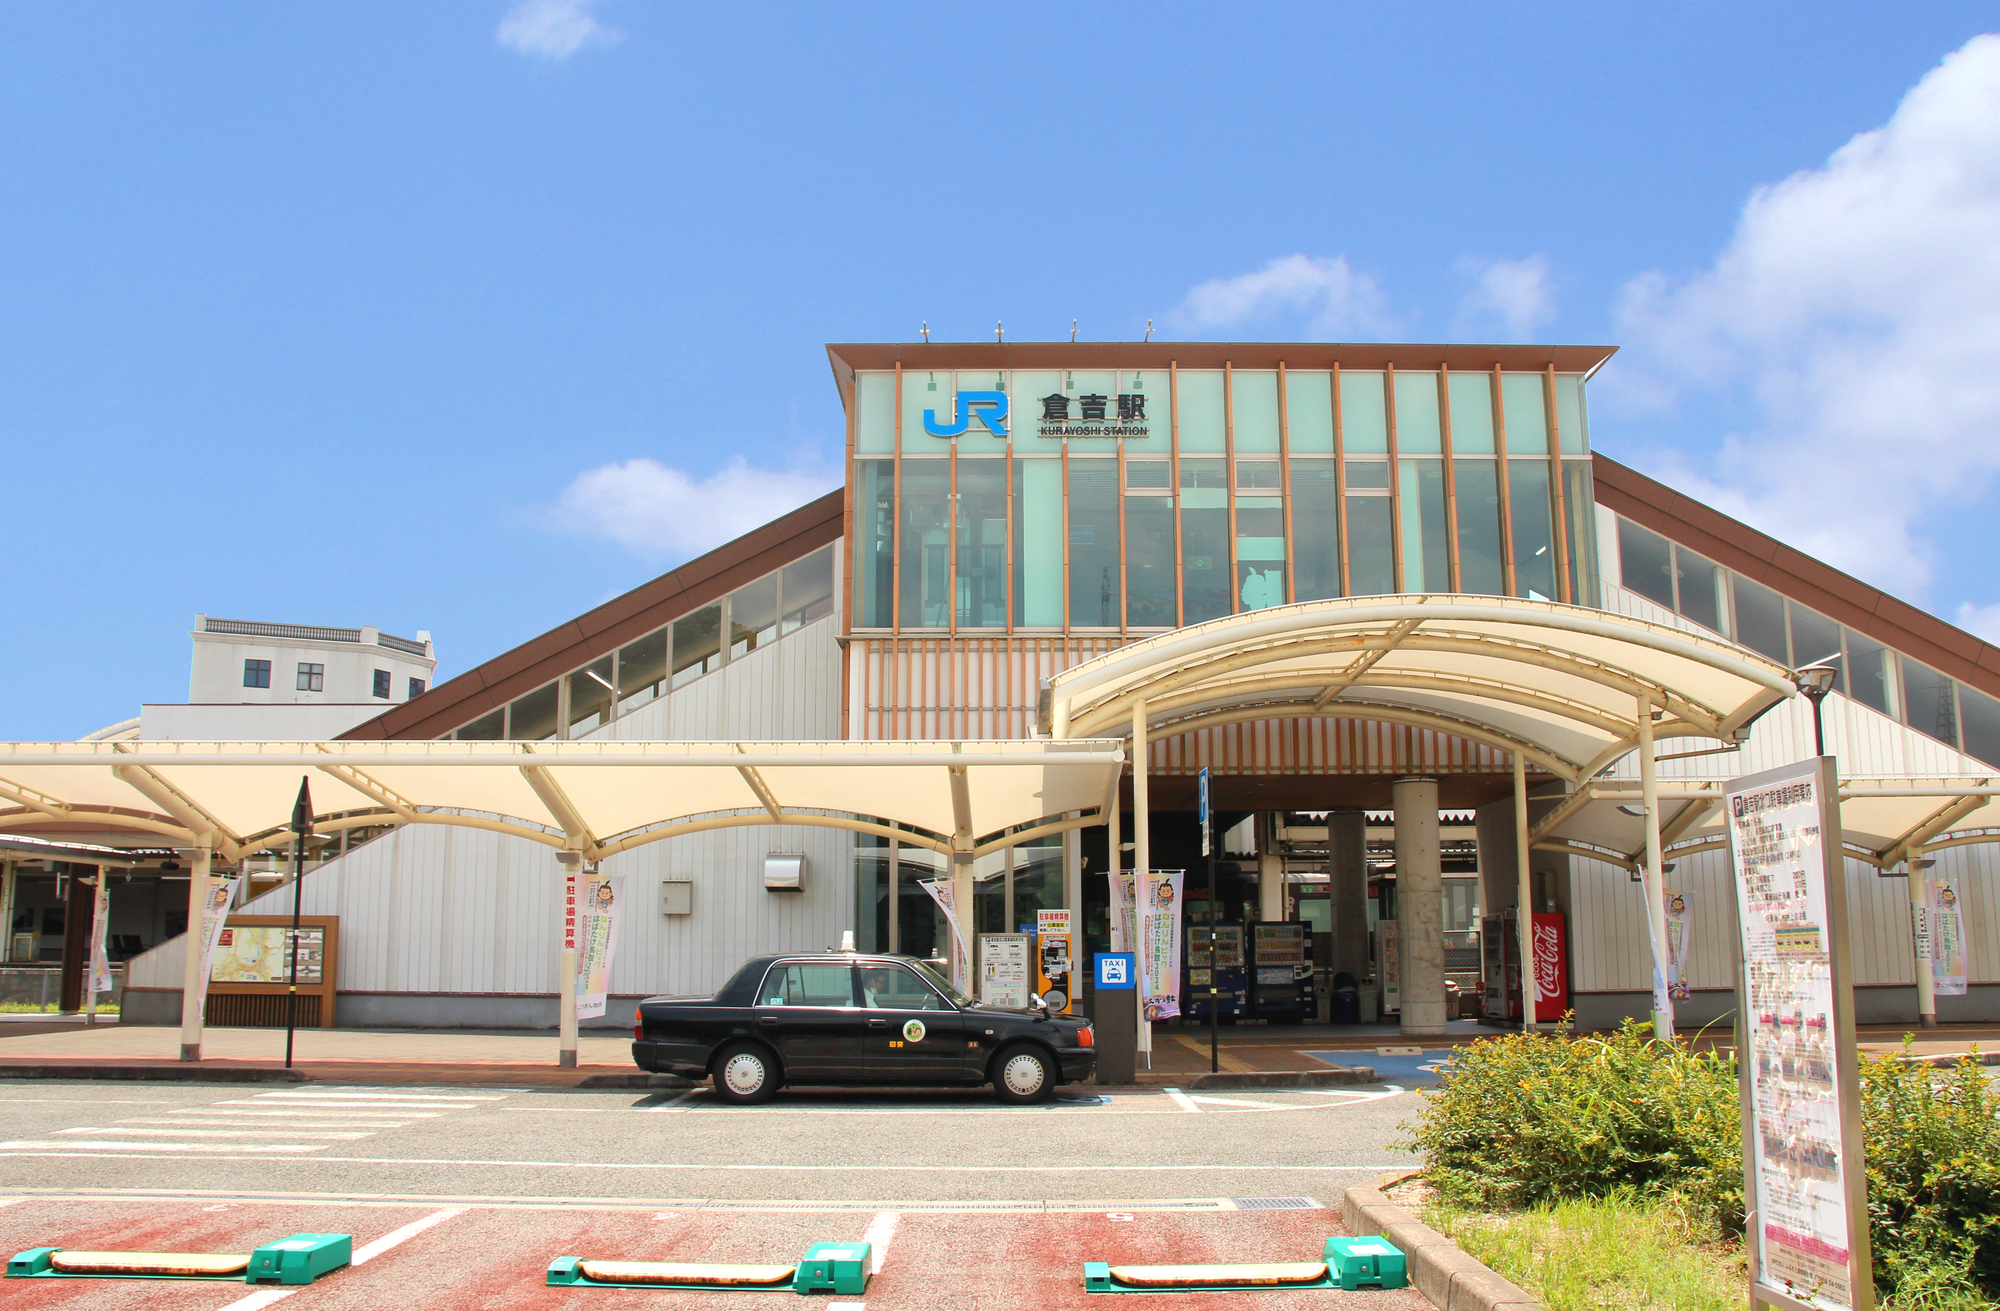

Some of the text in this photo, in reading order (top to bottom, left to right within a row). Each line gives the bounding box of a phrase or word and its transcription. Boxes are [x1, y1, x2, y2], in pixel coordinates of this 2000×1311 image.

[923, 391, 1009, 436] JR
[1042, 393, 1146, 421] 倉吉駅
[1040, 426, 1147, 436] KURAYOSHI STATION
[1201, 776, 1206, 817] P
[565, 885, 575, 949] 駐車場精算機
[1534, 921, 1560, 998] Coca-Cola
